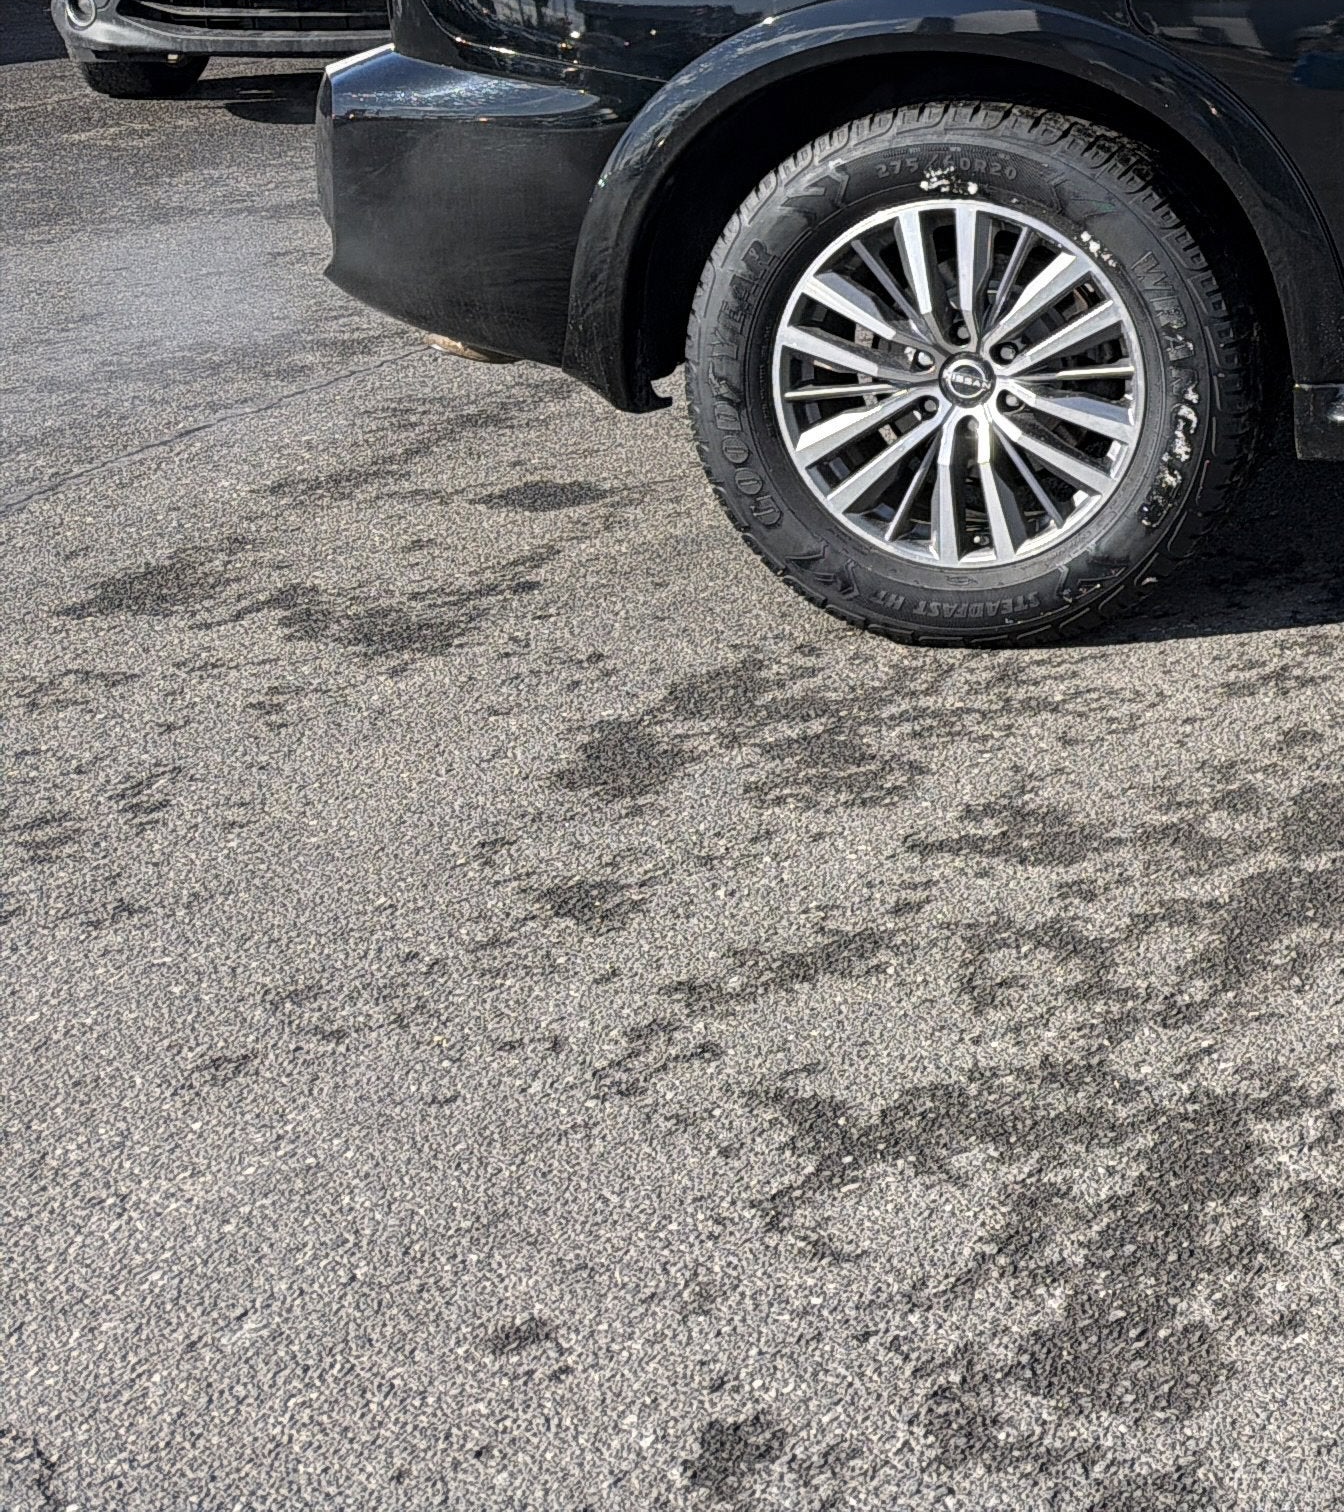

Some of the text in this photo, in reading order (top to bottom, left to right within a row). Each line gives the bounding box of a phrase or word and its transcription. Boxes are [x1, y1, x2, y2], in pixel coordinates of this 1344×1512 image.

[875, 153, 1018, 181] 275/60R20
[707, 239, 784, 529] GOODYEAR
[943, 369, 992, 390] NISSAN
[870, 590, 1041, 619] STEADFAST HT
